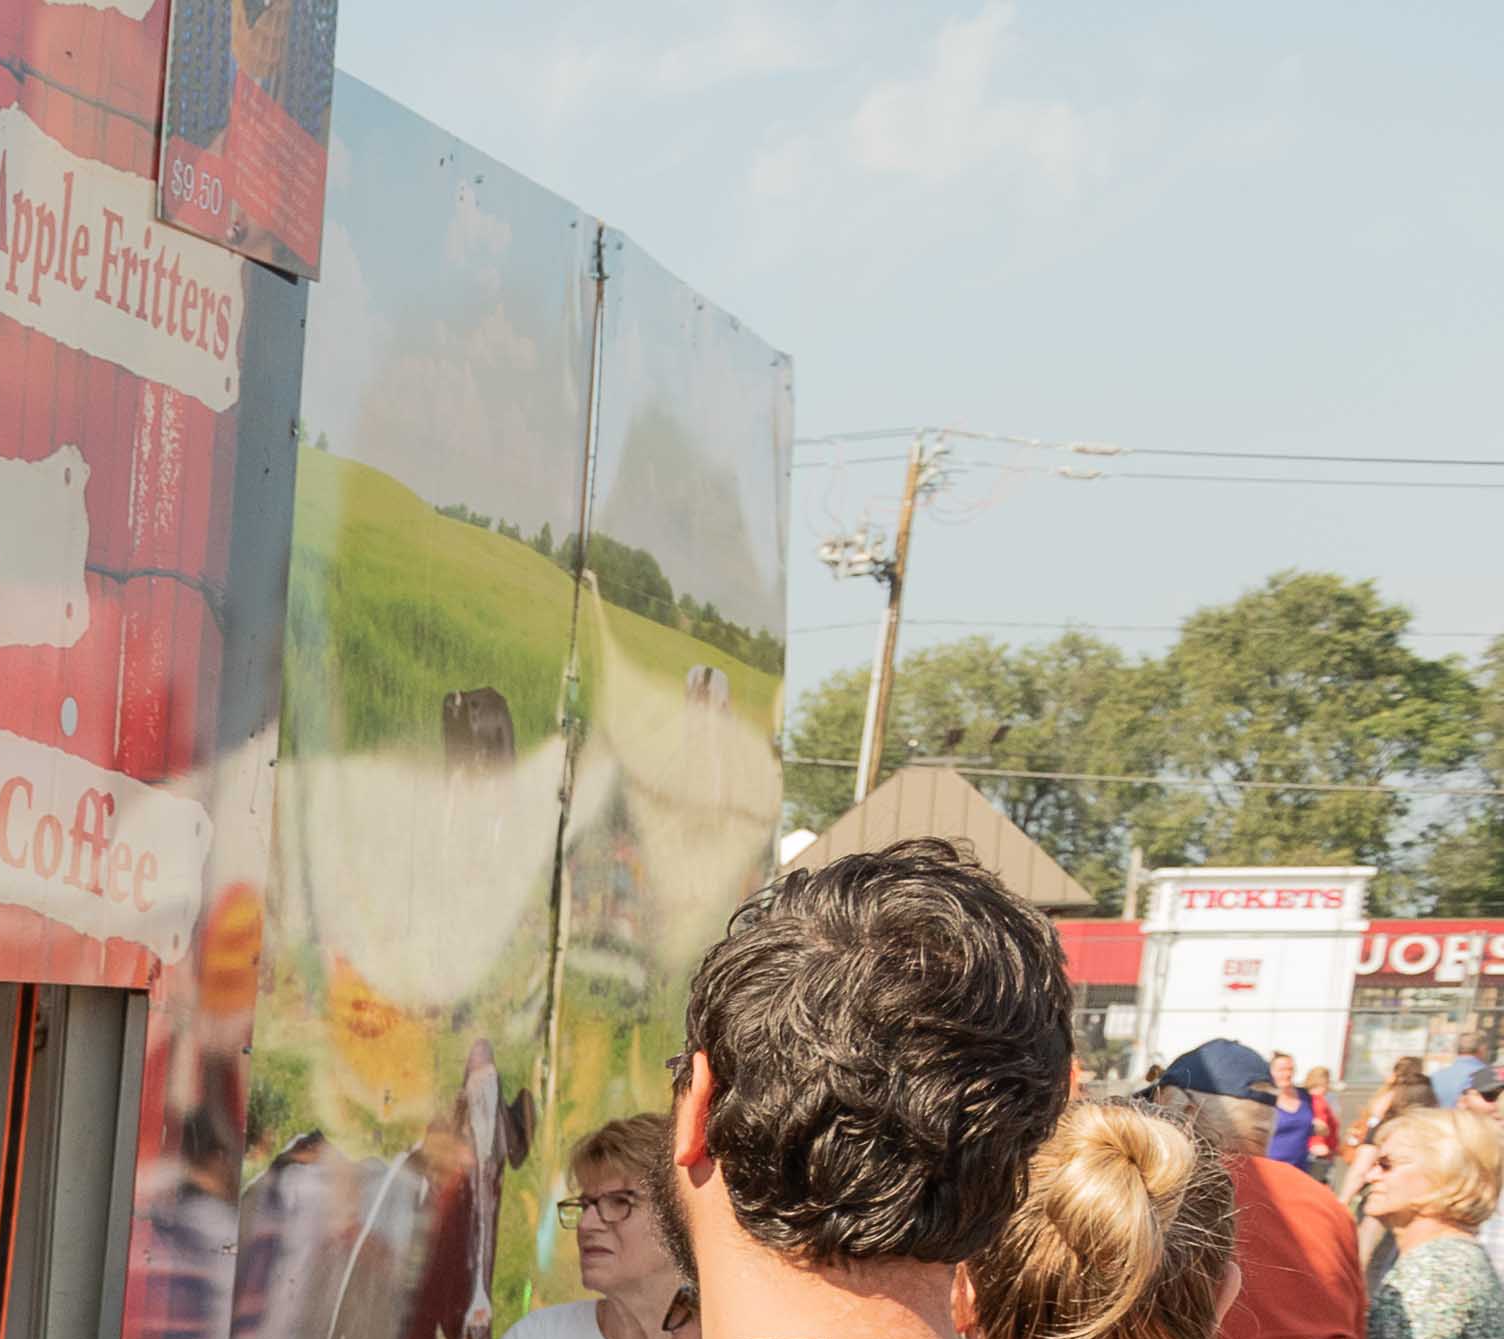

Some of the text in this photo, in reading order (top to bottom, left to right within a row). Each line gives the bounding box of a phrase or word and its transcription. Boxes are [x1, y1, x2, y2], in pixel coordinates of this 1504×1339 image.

[171, 155, 223, 217] $9.50
[95, 205, 232, 364] Fritters
[1181, 889, 1344, 909] TICKETS
